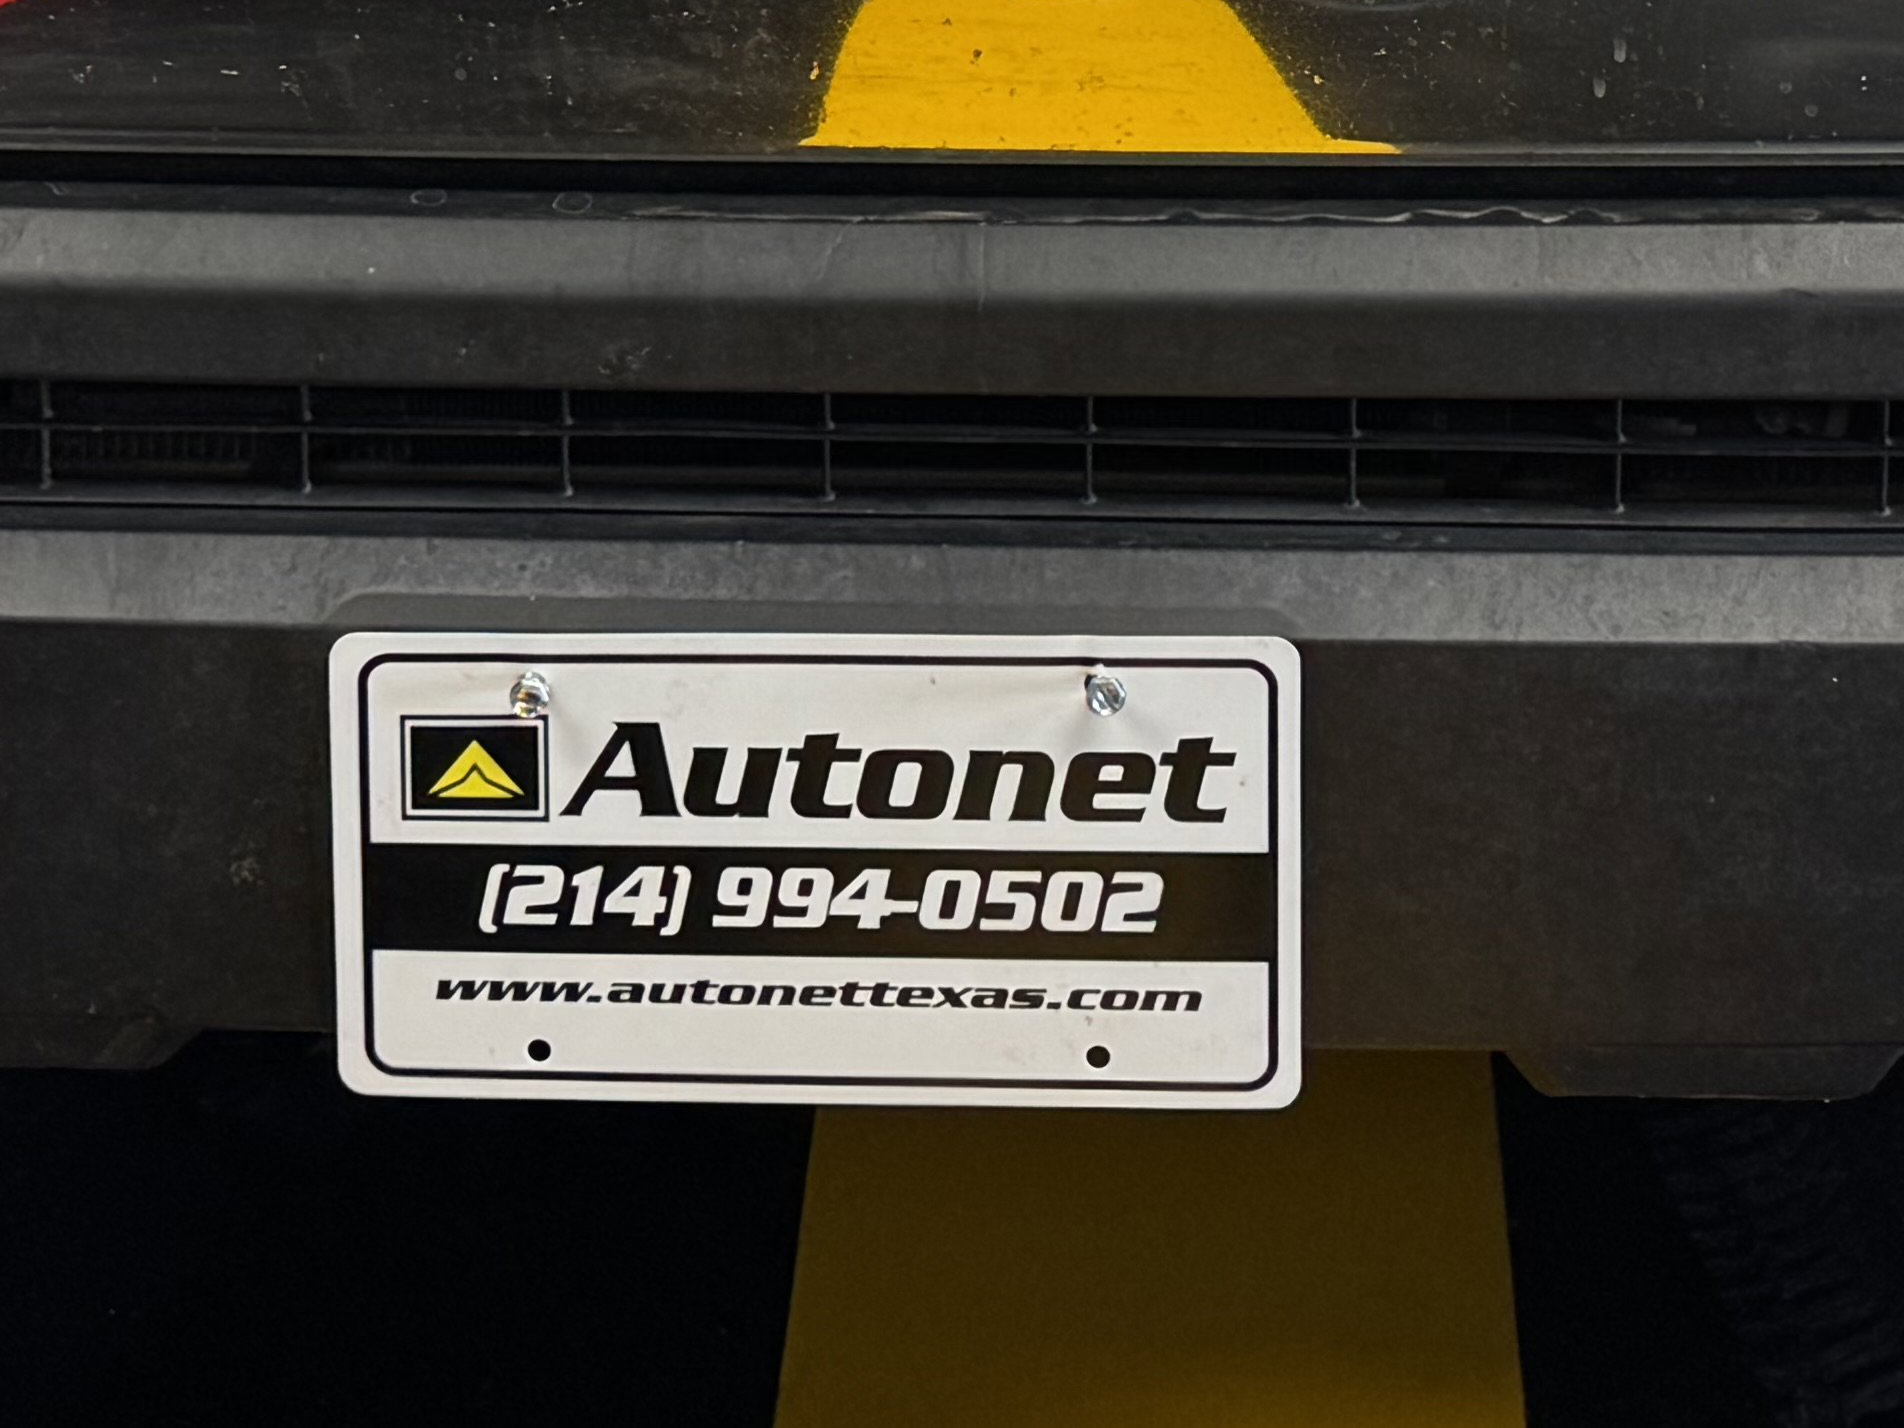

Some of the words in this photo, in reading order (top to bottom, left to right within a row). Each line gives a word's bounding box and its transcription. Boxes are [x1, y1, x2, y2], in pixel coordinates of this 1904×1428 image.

[560, 721, 1237, 823] Autonet
[478, 863, 692, 935] (214)
[712, 866, 1164, 933] 994-0502
[435, 978, 1203, 1013] www.autonettexas.com
